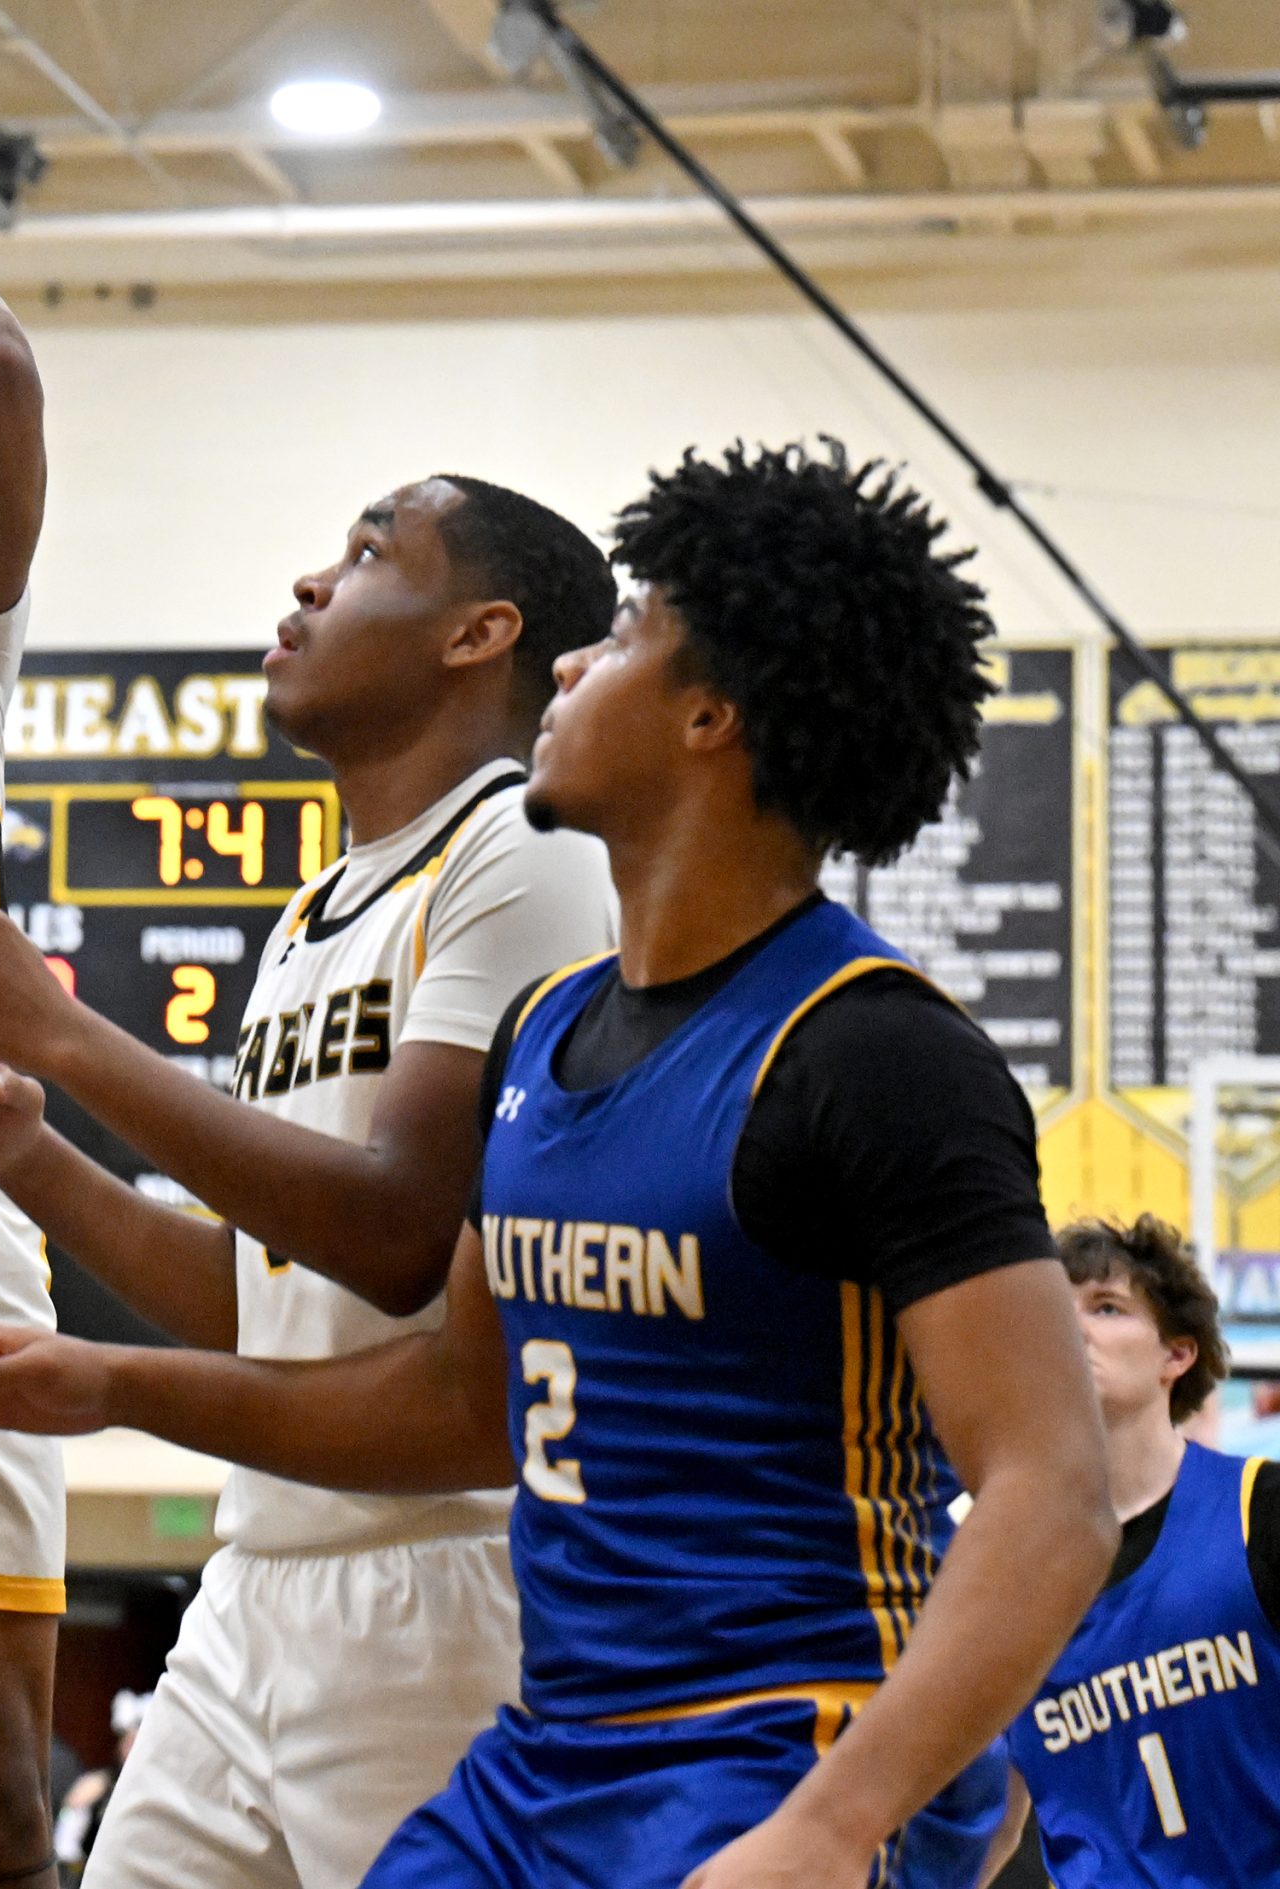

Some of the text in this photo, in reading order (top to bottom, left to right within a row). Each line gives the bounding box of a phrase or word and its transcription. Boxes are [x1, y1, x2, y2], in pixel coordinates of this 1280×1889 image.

[131, 796, 323, 886] 7:41
[165, 964, 217, 1044] 2
[482, 1213, 706, 1321] UTHERN
[521, 1338, 587, 1505] 2
[1033, 1630, 1259, 1754] SOUTHERN
[1137, 1732, 1188, 1838] 1
